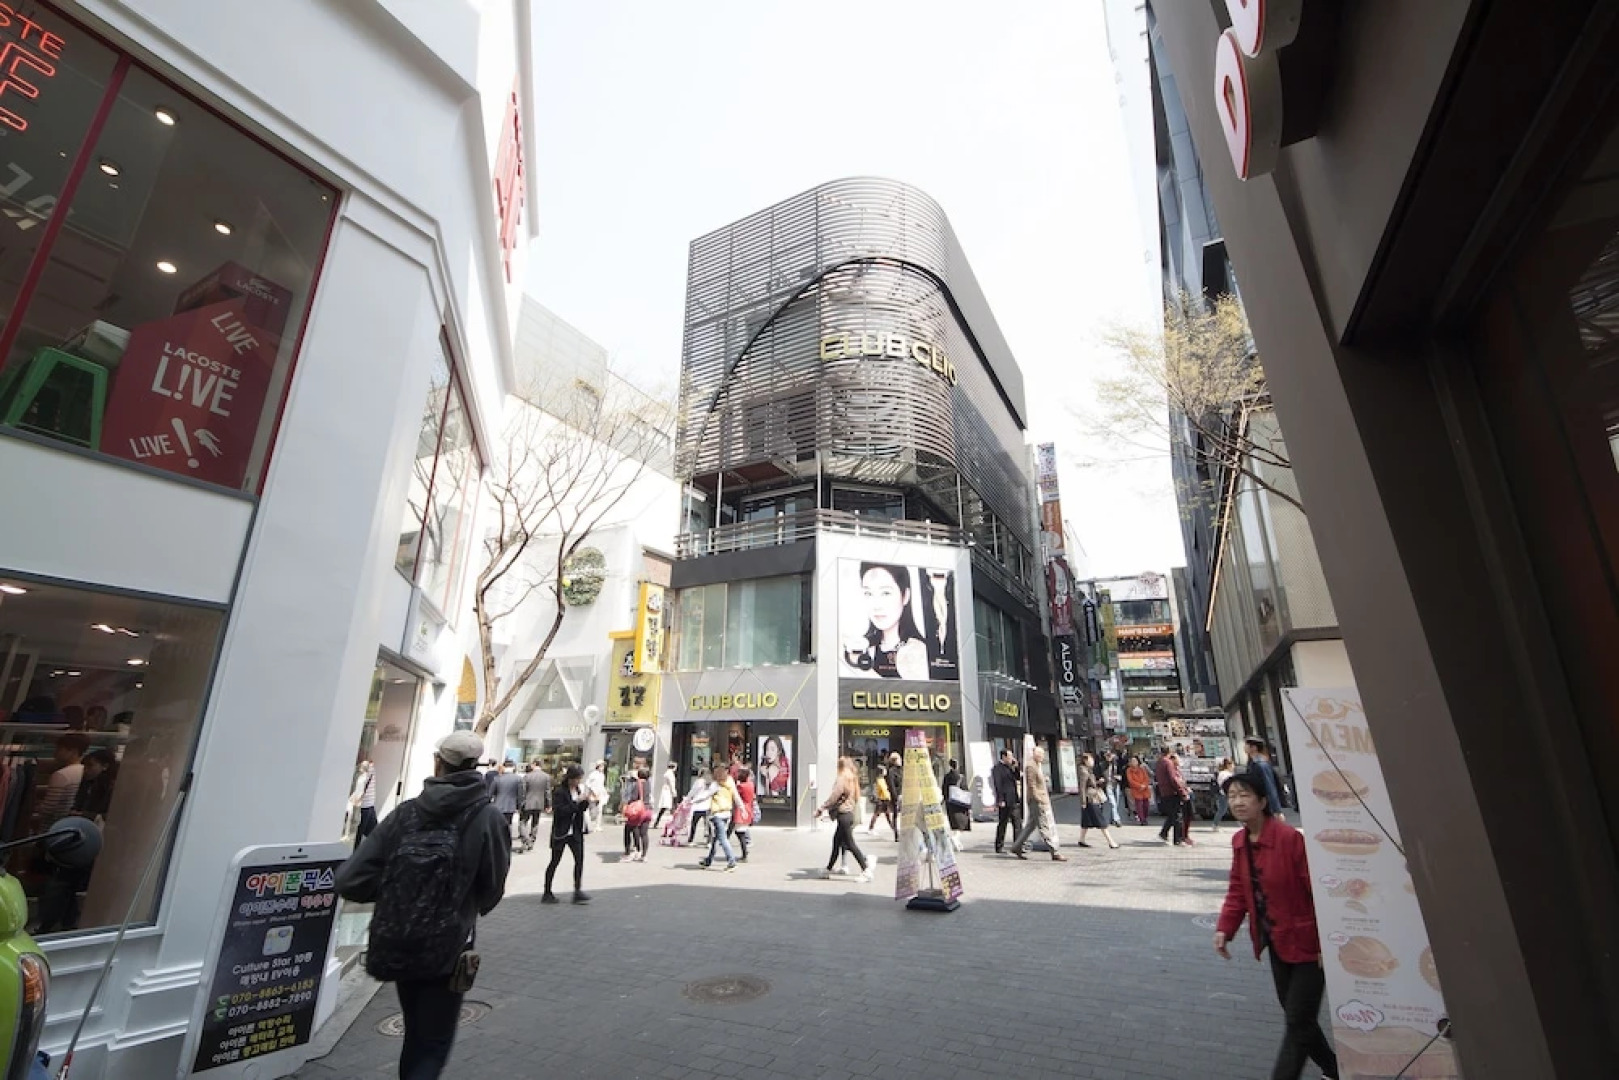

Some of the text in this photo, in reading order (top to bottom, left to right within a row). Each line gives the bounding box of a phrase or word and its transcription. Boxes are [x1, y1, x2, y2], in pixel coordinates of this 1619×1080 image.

[164, 342, 242, 380] LACOSTE
[1061, 642, 1074, 682] ALDO
[689, 692, 779, 711] CLUBCLIO
[851, 690, 951, 711] CLUBCLIO
[232, 960, 270, 975] Culture
